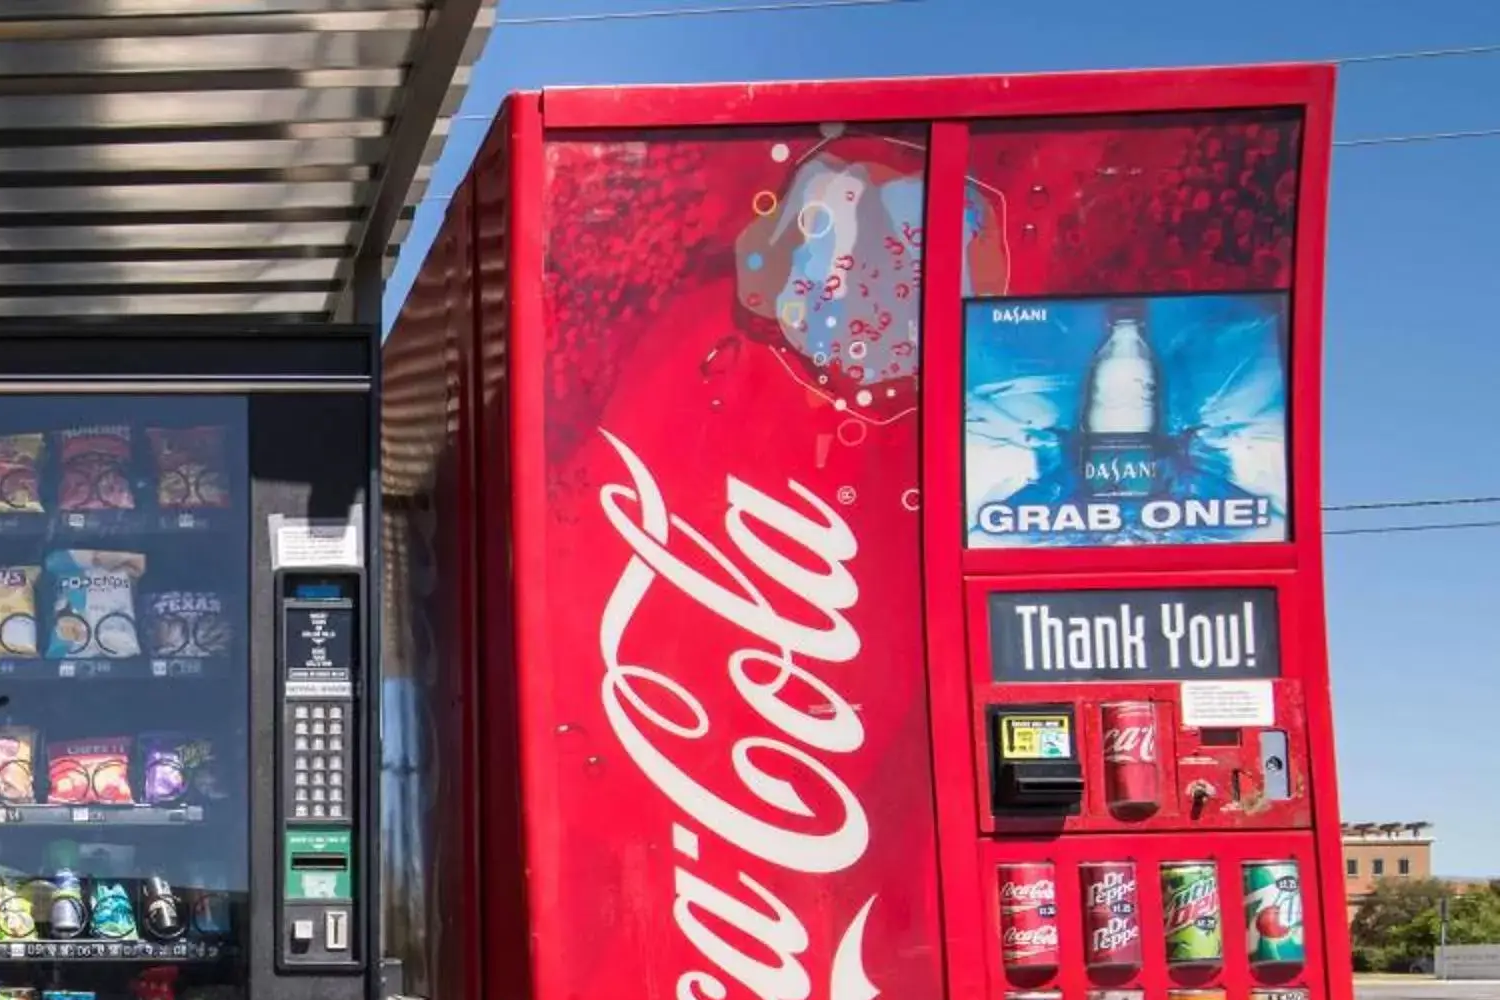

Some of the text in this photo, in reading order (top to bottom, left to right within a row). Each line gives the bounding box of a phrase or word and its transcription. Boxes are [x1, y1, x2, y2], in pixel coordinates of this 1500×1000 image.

[992, 307, 1047, 325] DASANI
[1085, 457, 1156, 483] DASANI
[979, 498, 1271, 534] GRAB ONE!
[1014, 601, 1258, 671] Thank You!
